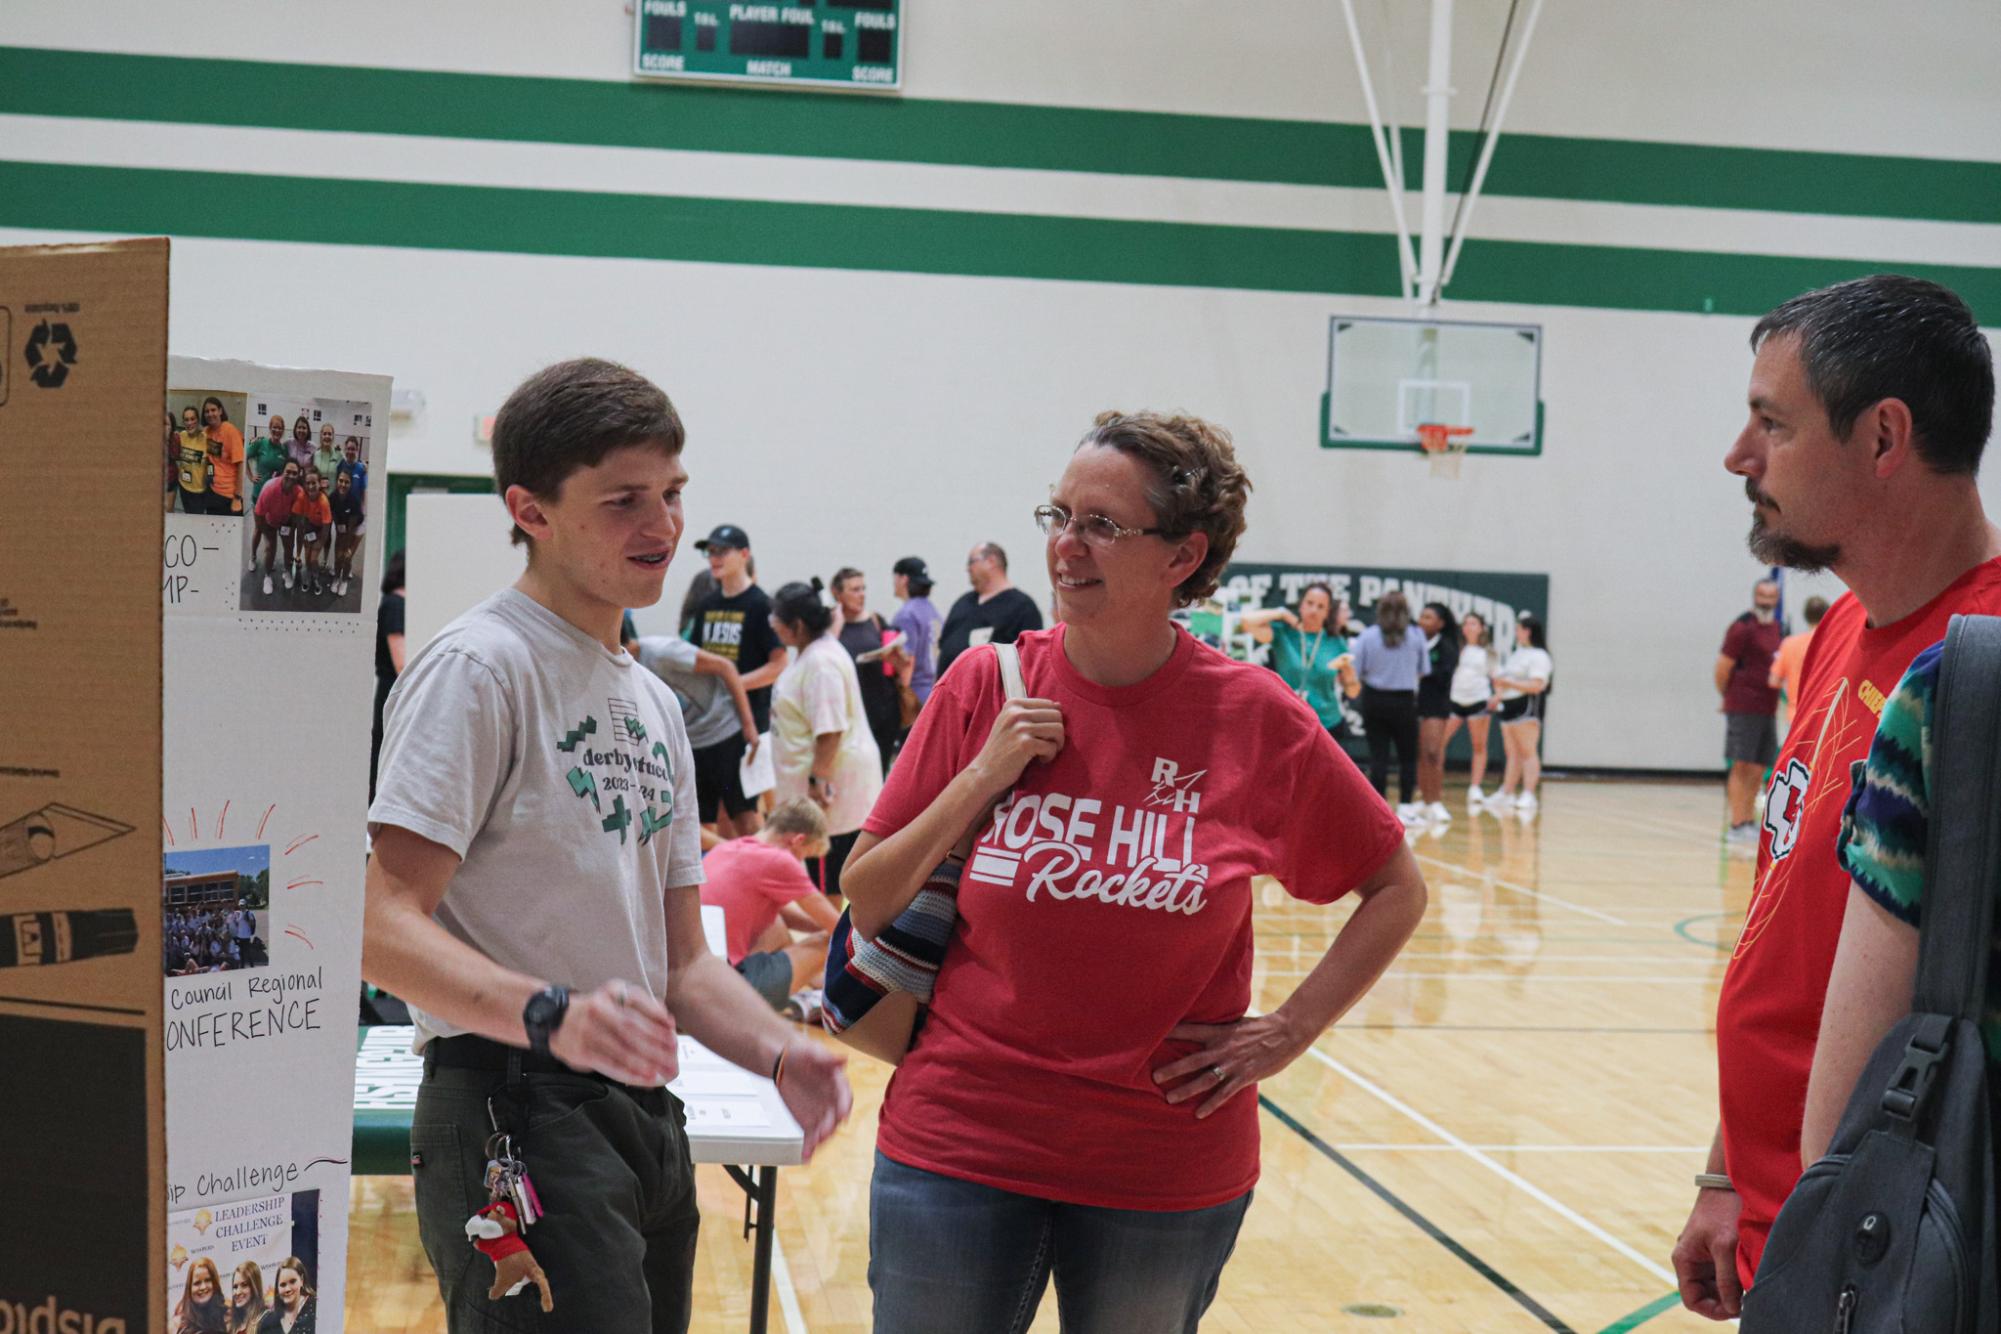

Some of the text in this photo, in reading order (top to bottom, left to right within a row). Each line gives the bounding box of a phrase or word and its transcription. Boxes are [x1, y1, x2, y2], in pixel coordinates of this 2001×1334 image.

[644, 0, 687, 17] FOULS
[729, 4, 779, 22] PLAYER
[854, 11, 896, 30] FOULS
[642, 53, 685, 70] SCORE
[746, 59, 791, 77] MATCH
[852, 65, 894, 83] SCORE
[1280, 572, 1351, 604] TE
[1151, 756, 1179, 788] R
[1024, 840, 1208, 916] Rockets
[248, 966, 322, 1004] Regional
[197, 1162, 300, 1196] Challenge
[214, 1196, 286, 1223] LEADERSHIP
[215, 1214, 284, 1239] CHALLENGE
[231, 1234, 268, 1252] EVENT
